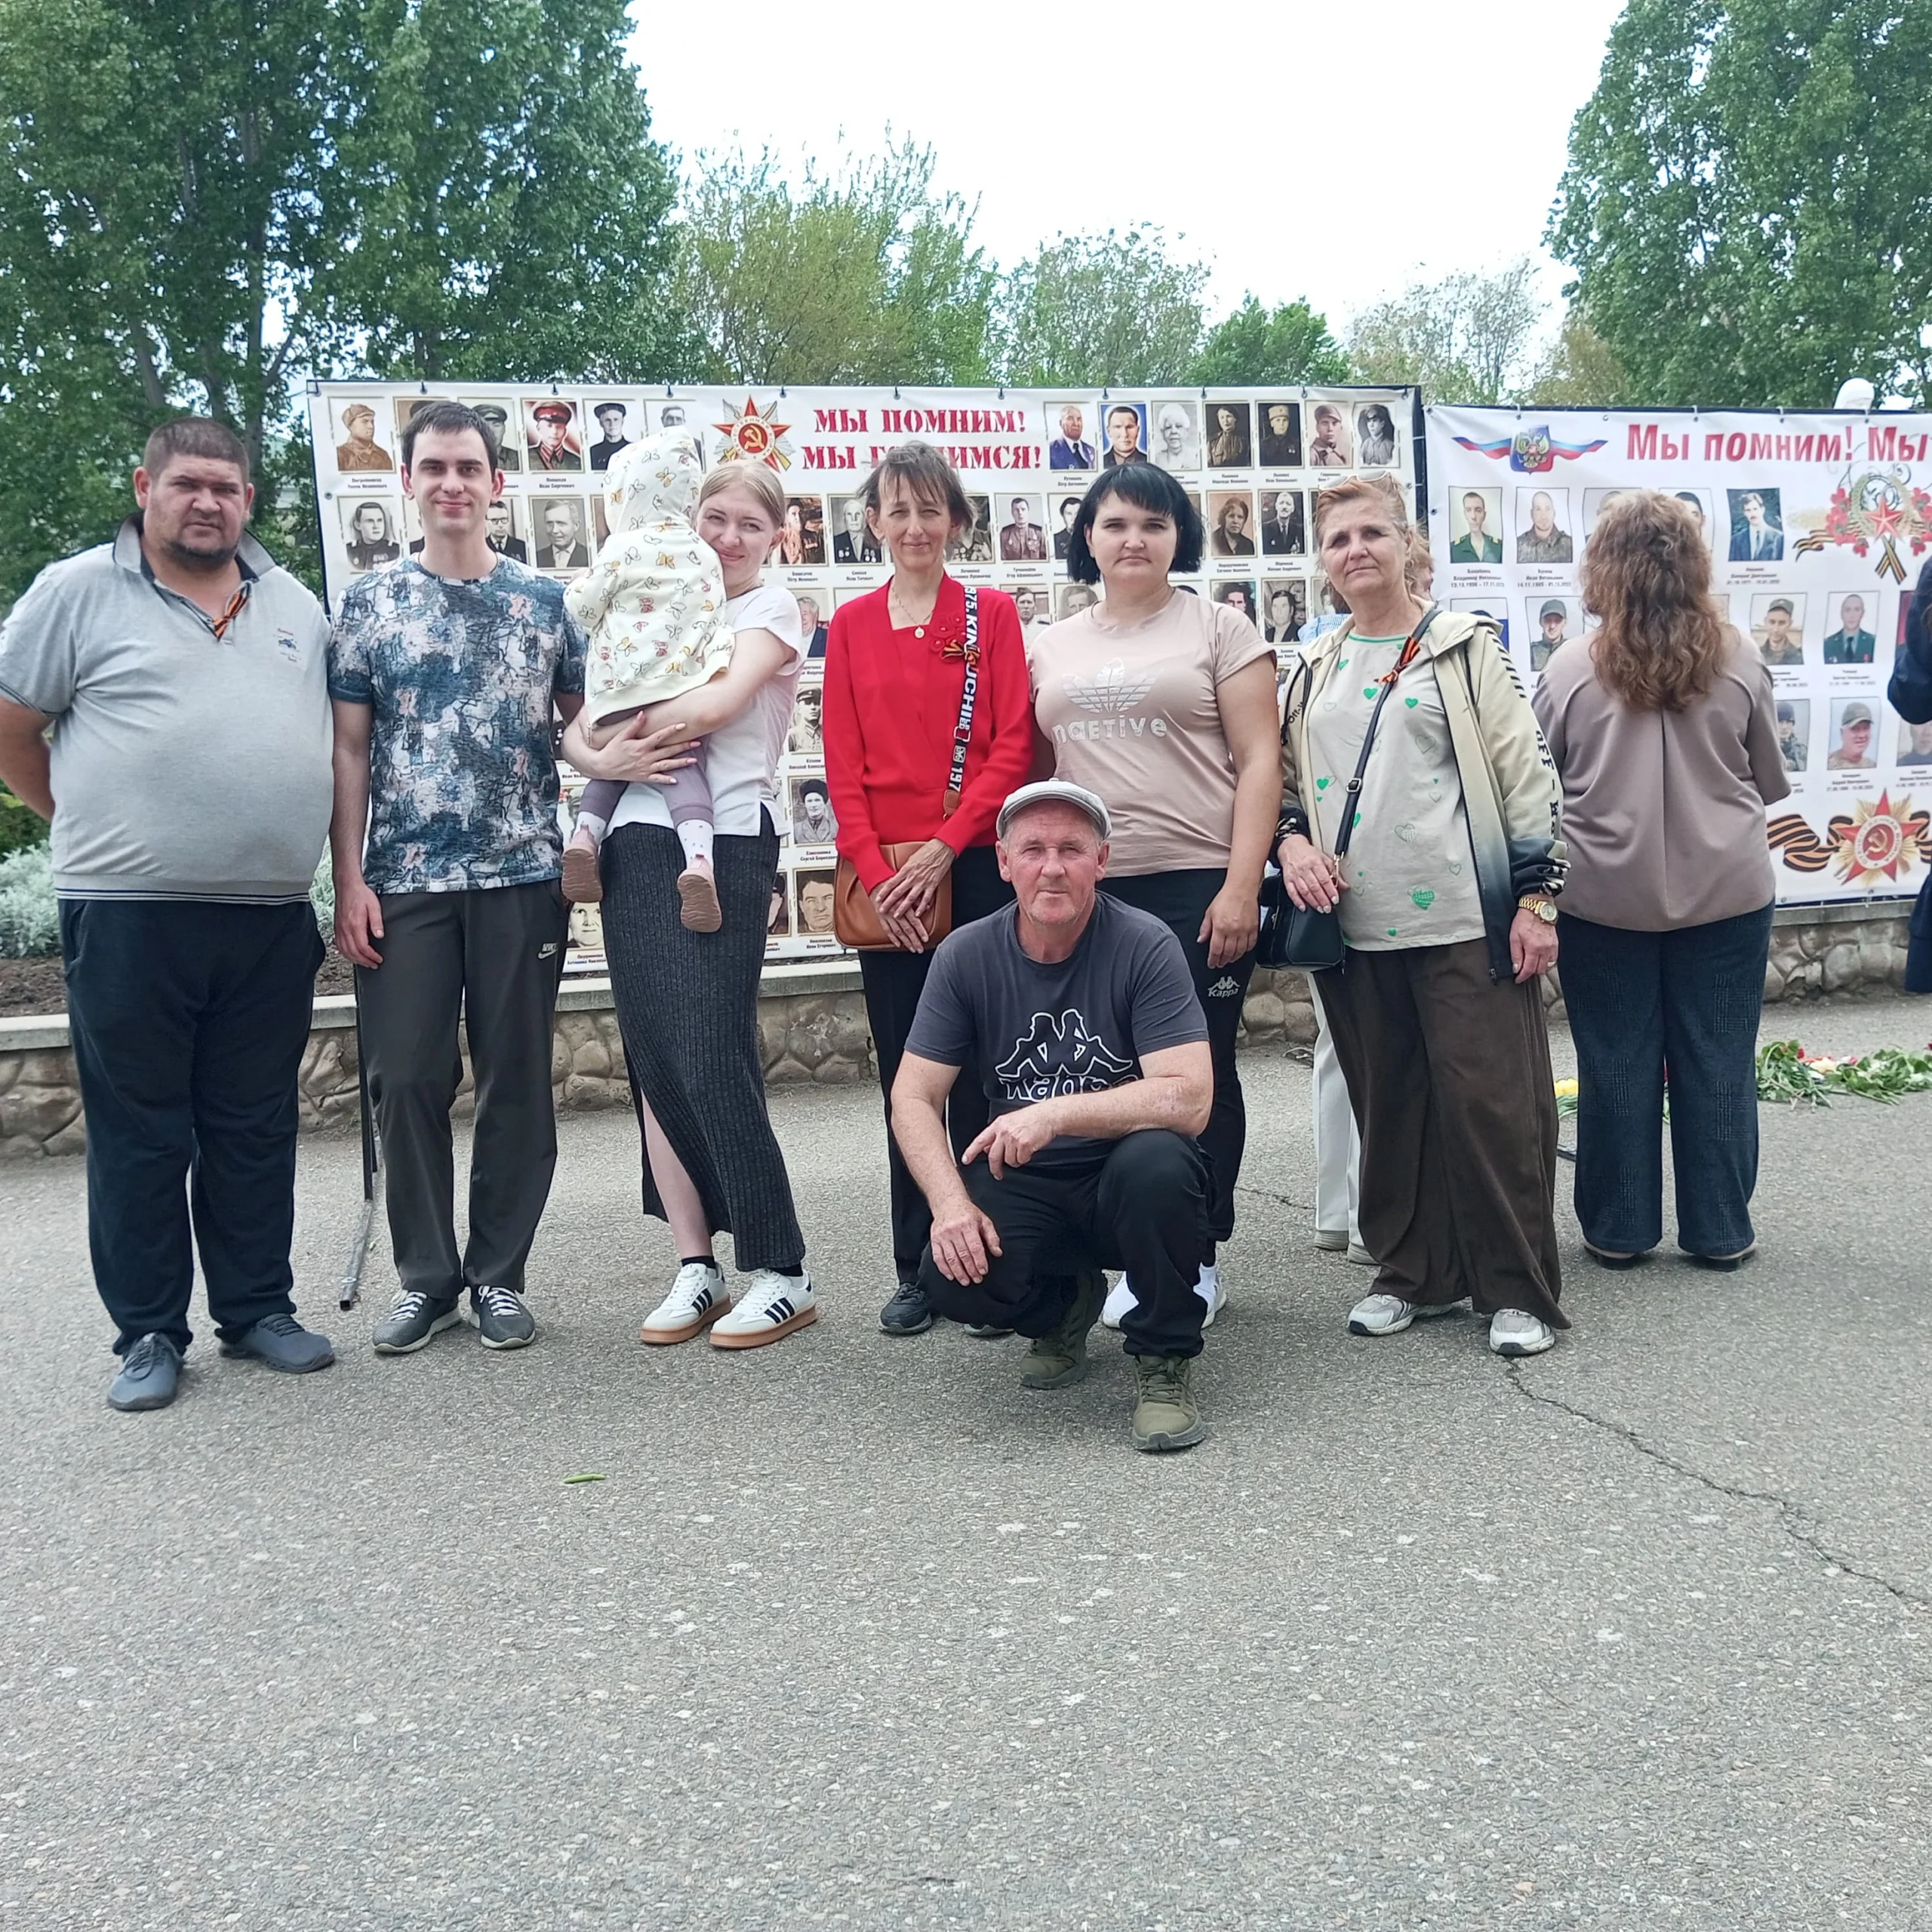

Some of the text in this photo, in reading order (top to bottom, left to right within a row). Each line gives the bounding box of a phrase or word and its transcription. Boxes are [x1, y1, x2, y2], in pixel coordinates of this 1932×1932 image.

[813, 409, 1026, 432] МЫ ПОМНИМ!
[1626, 424, 1927, 463] Мы помним! Мы
[801, 446, 1041, 469] МЫ ГИМСЯ!
[959, 616, 979, 721] KINUCHI
[1208, 988, 1239, 998] Kappa
